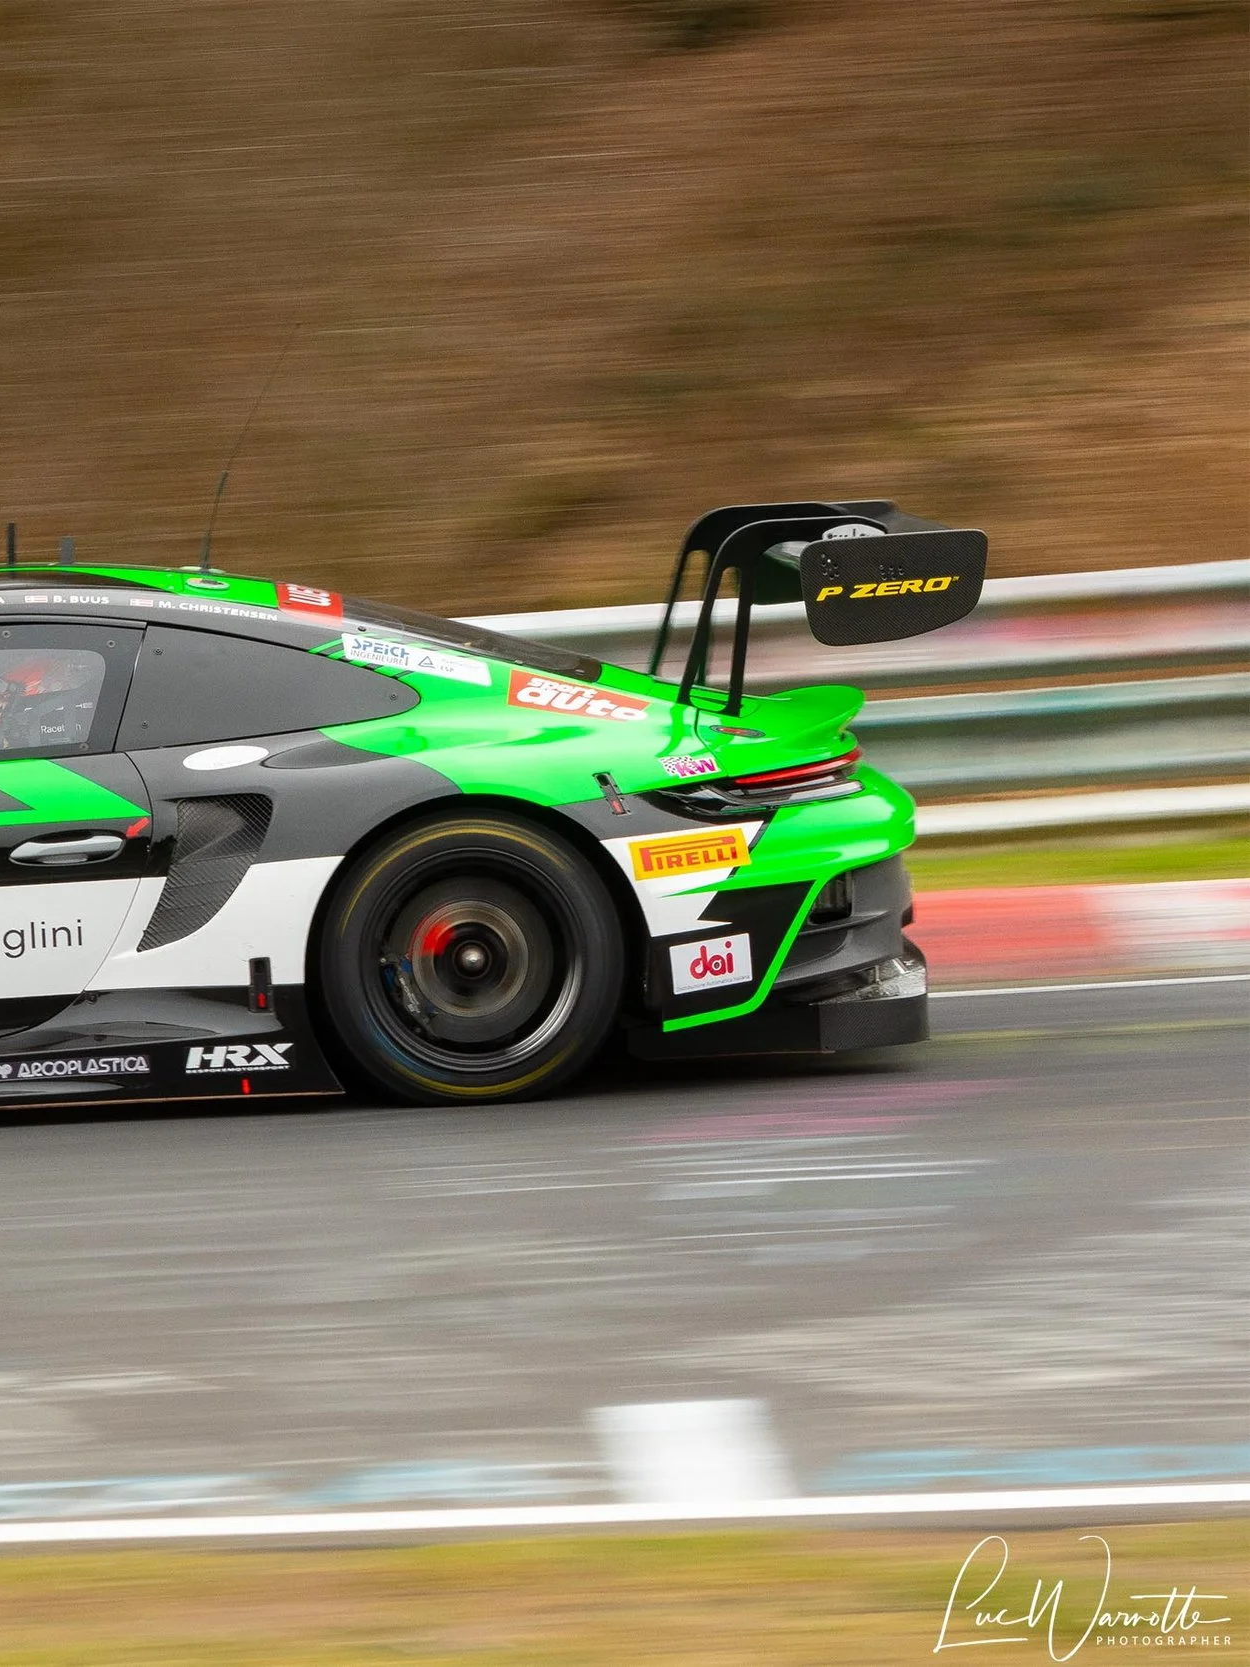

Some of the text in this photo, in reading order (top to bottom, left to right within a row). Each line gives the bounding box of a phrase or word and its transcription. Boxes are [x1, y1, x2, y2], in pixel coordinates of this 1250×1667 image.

[53, 595, 110, 604] B. BUUS
[816, 586, 844, 602] P
[158, 600, 278, 621] M. CHRISTENSEN
[527, 677, 598, 697] sport
[516, 686, 649, 721] auto
[675, 759, 717, 778] KW
[639, 836, 738, 872] PIRELLI
[690, 941, 735, 979] dai
[185, 1043, 294, 1067] HRX
